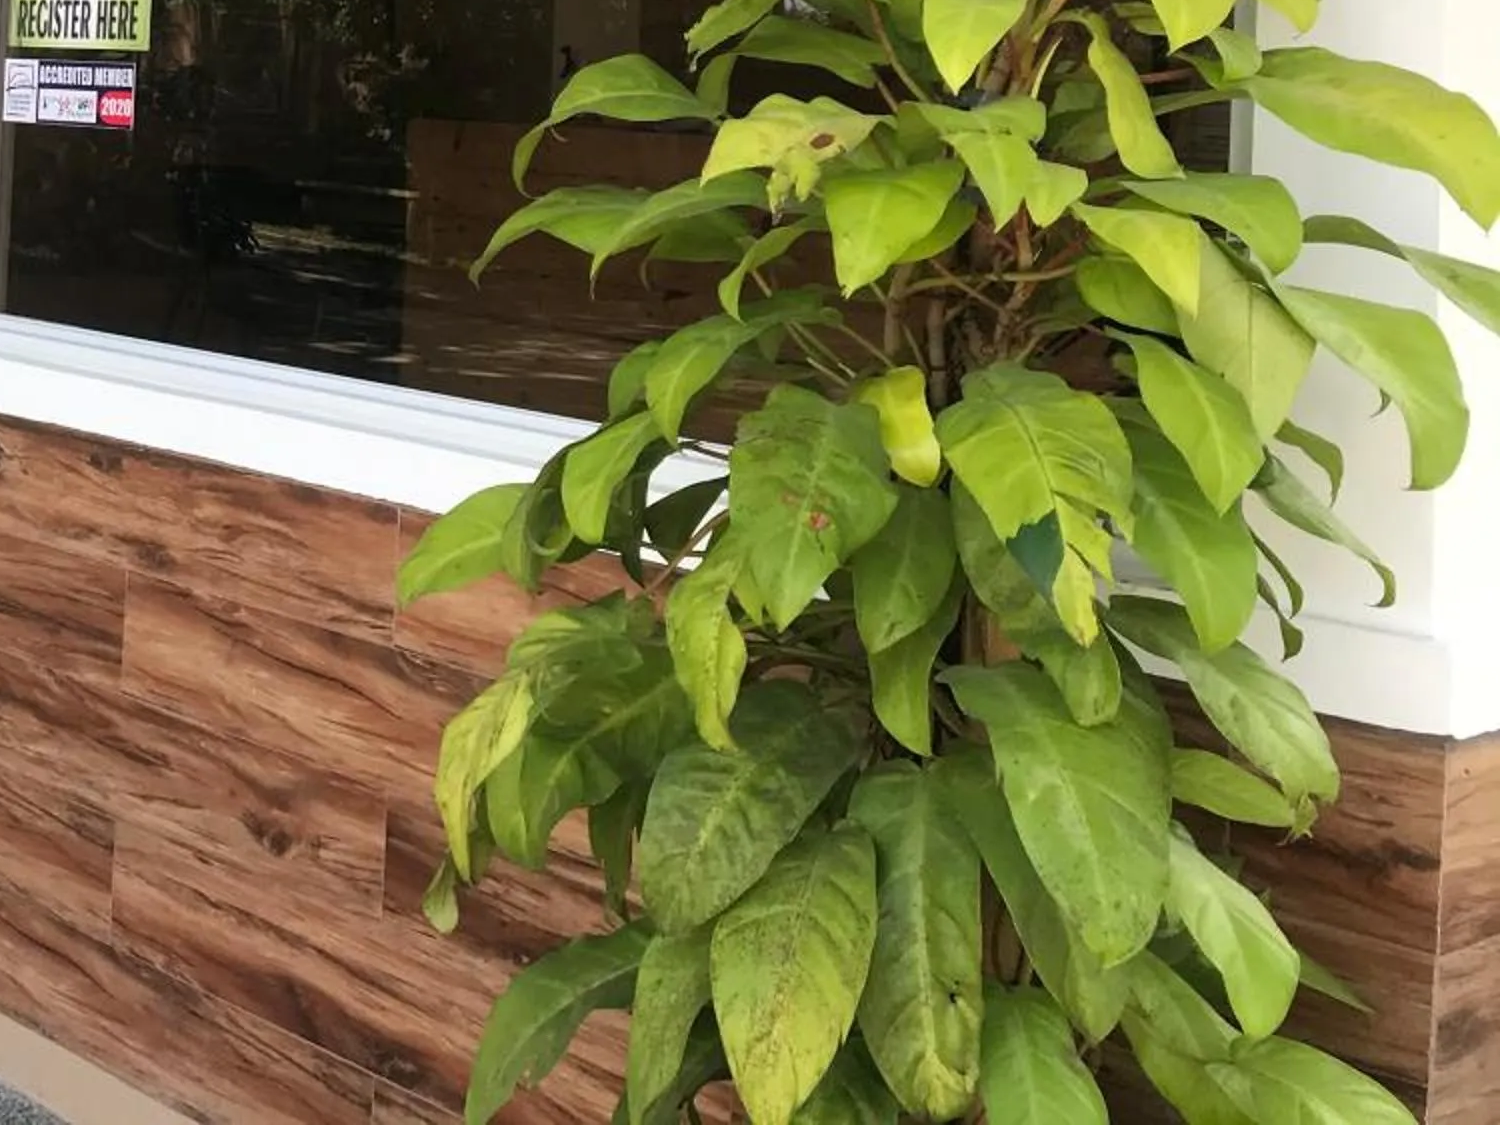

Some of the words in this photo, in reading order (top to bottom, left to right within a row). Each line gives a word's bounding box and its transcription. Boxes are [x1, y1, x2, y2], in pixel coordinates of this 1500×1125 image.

[96, 0, 139, 40] HERE
[39, 65, 93, 86] ACCREDITED
[94, 67, 134, 88] MEMBER
[101, 97, 132, 117] 2020
